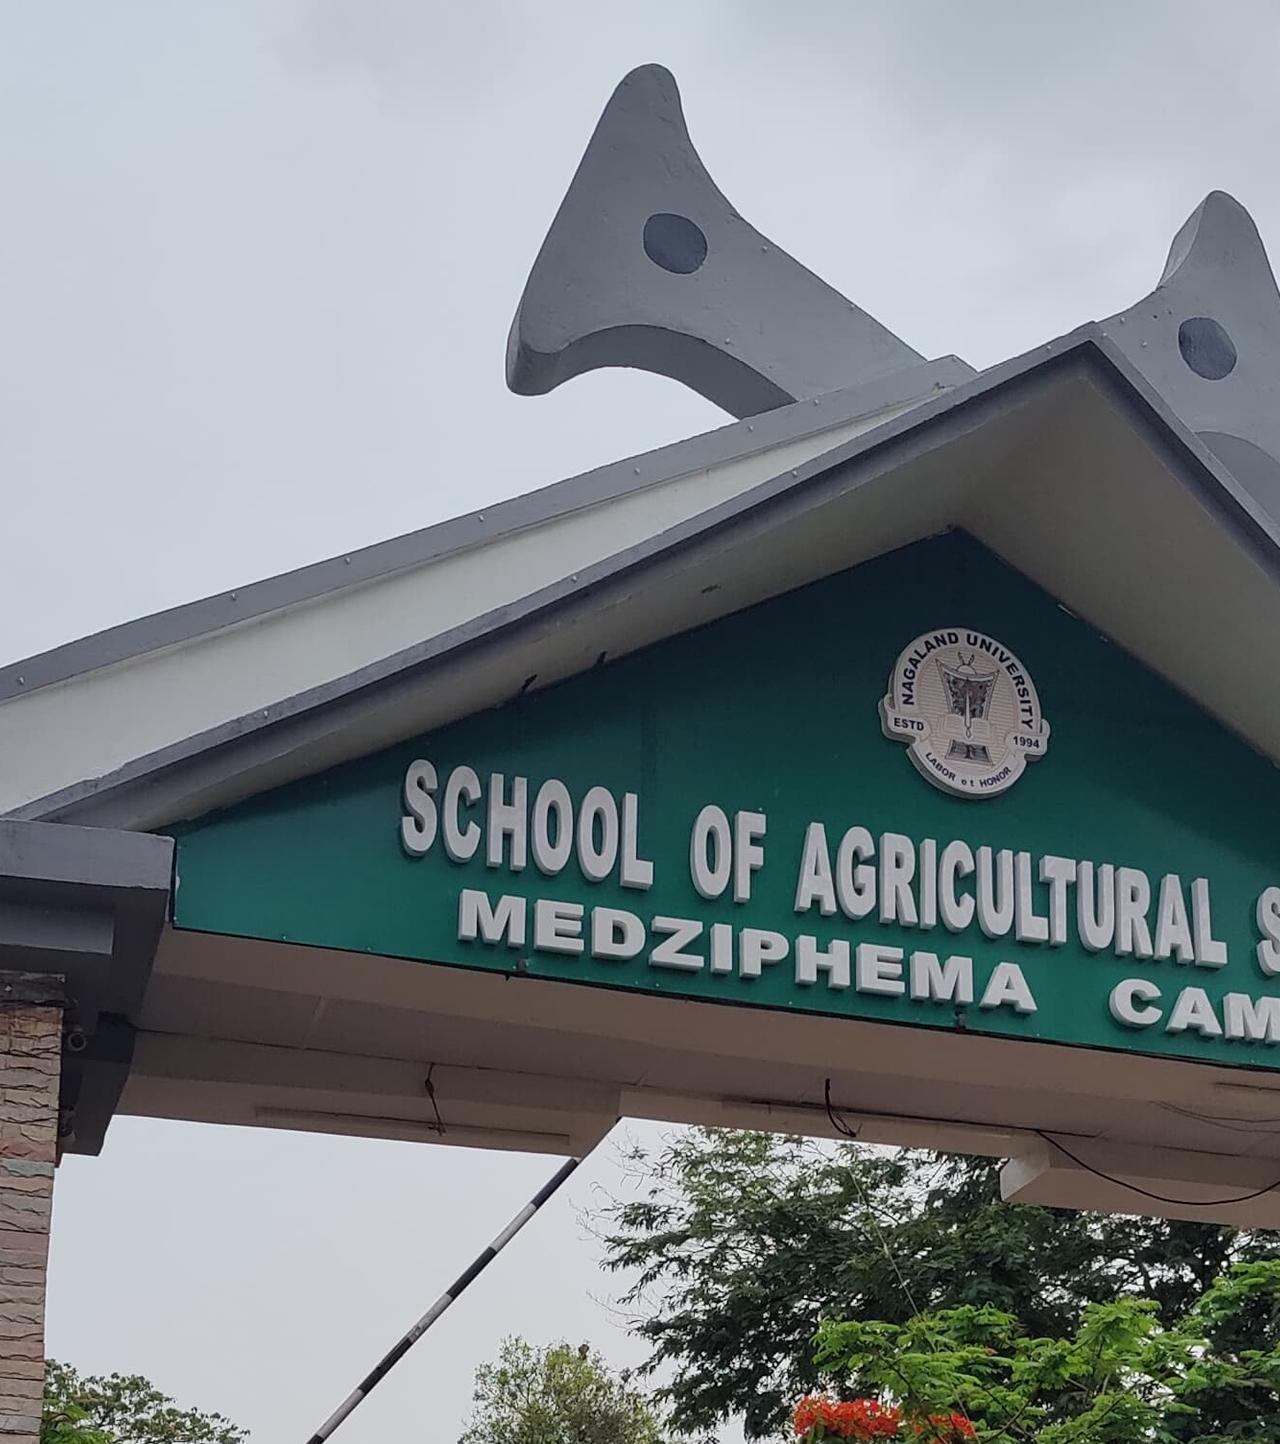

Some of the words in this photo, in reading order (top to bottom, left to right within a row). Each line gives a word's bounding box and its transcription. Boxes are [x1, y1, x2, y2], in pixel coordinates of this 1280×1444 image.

[902, 632, 959, 705] NAGALAND
[966, 634, 1034, 730] UNIVERSITY
[894, 718, 924, 732] ESTD
[1013, 736, 1040, 748] 1994
[926, 752, 956, 782] LABOR
[980, 766, 1012, 788] HONOR
[402, 758, 654, 890] SCHOOL
[690, 804, 767, 904] OF
[794, 821, 1227, 969] AGRICULTURAL
[458, 889, 1037, 1014] MEDZIPHEMA
